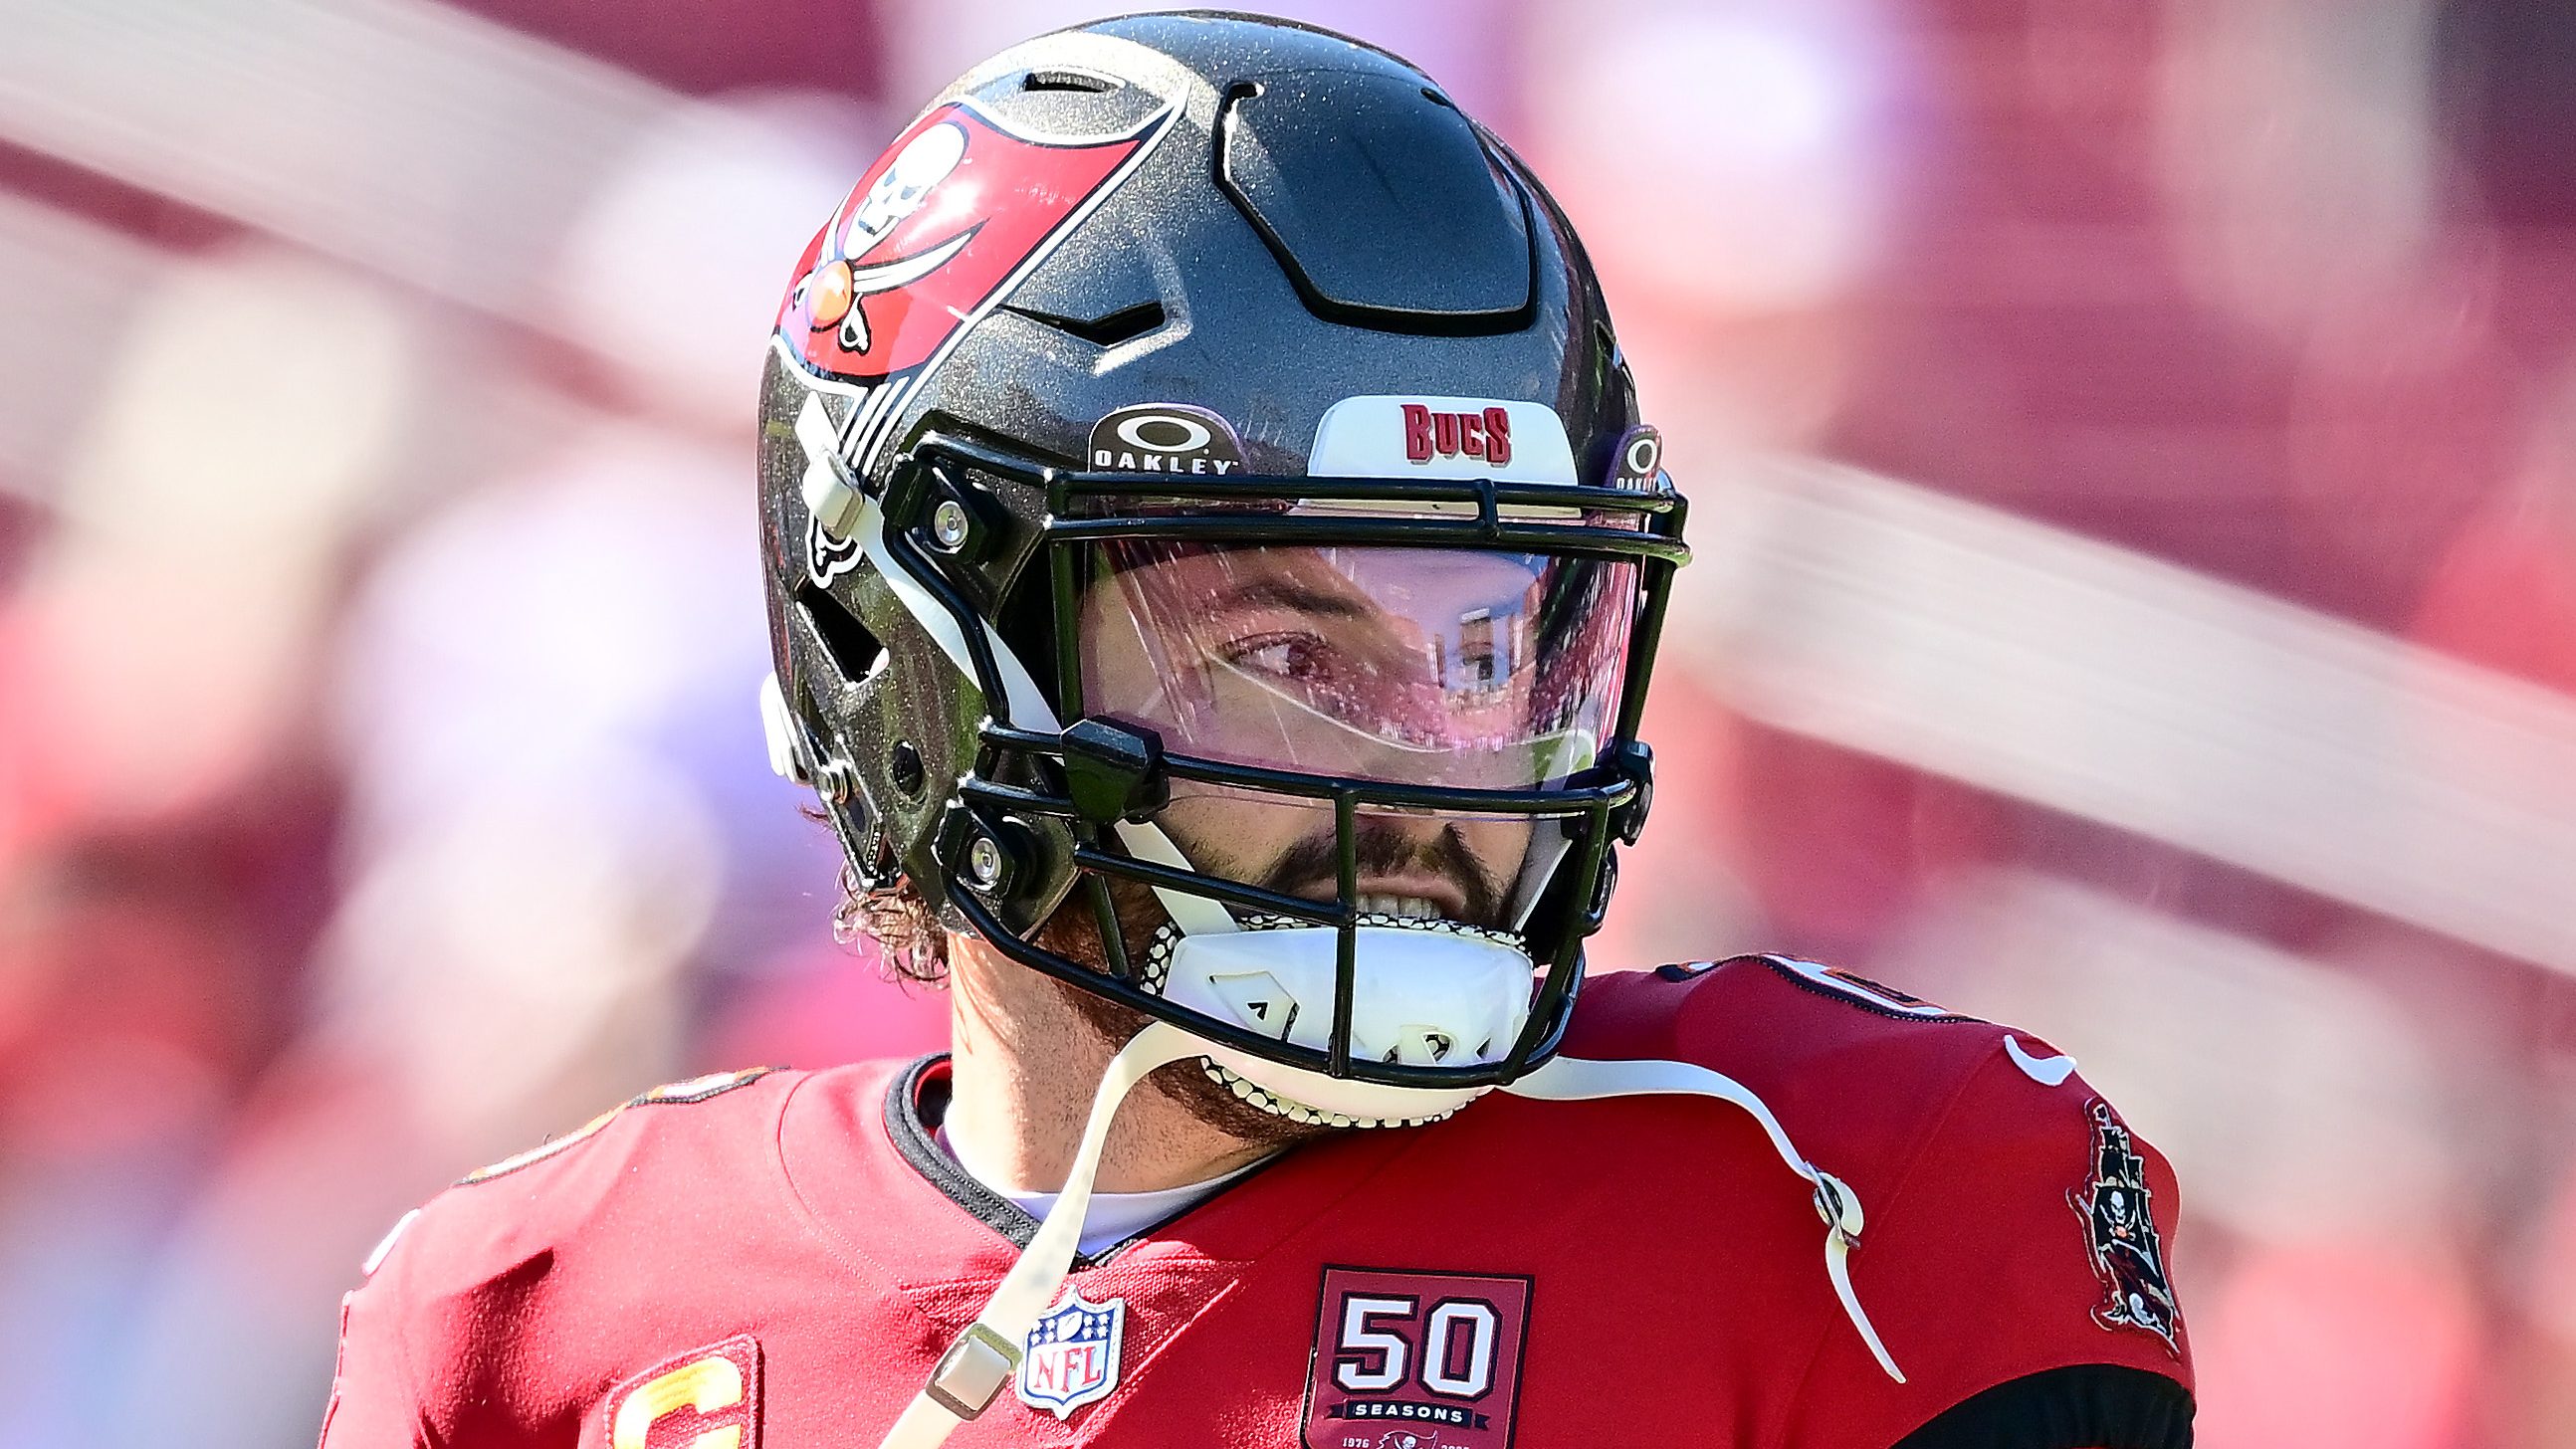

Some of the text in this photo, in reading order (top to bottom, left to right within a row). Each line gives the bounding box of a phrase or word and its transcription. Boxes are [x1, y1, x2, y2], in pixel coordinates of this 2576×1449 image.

[1399, 404, 1512, 468] BUCS
[1094, 449, 1232, 476] OAKLEY
[1335, 1294, 1500, 1399] 50
[1033, 1345, 1102, 1393] NFL
[1355, 1403, 1463, 1423] SEASONS
[1342, 1437, 1371, 1449] 1976
